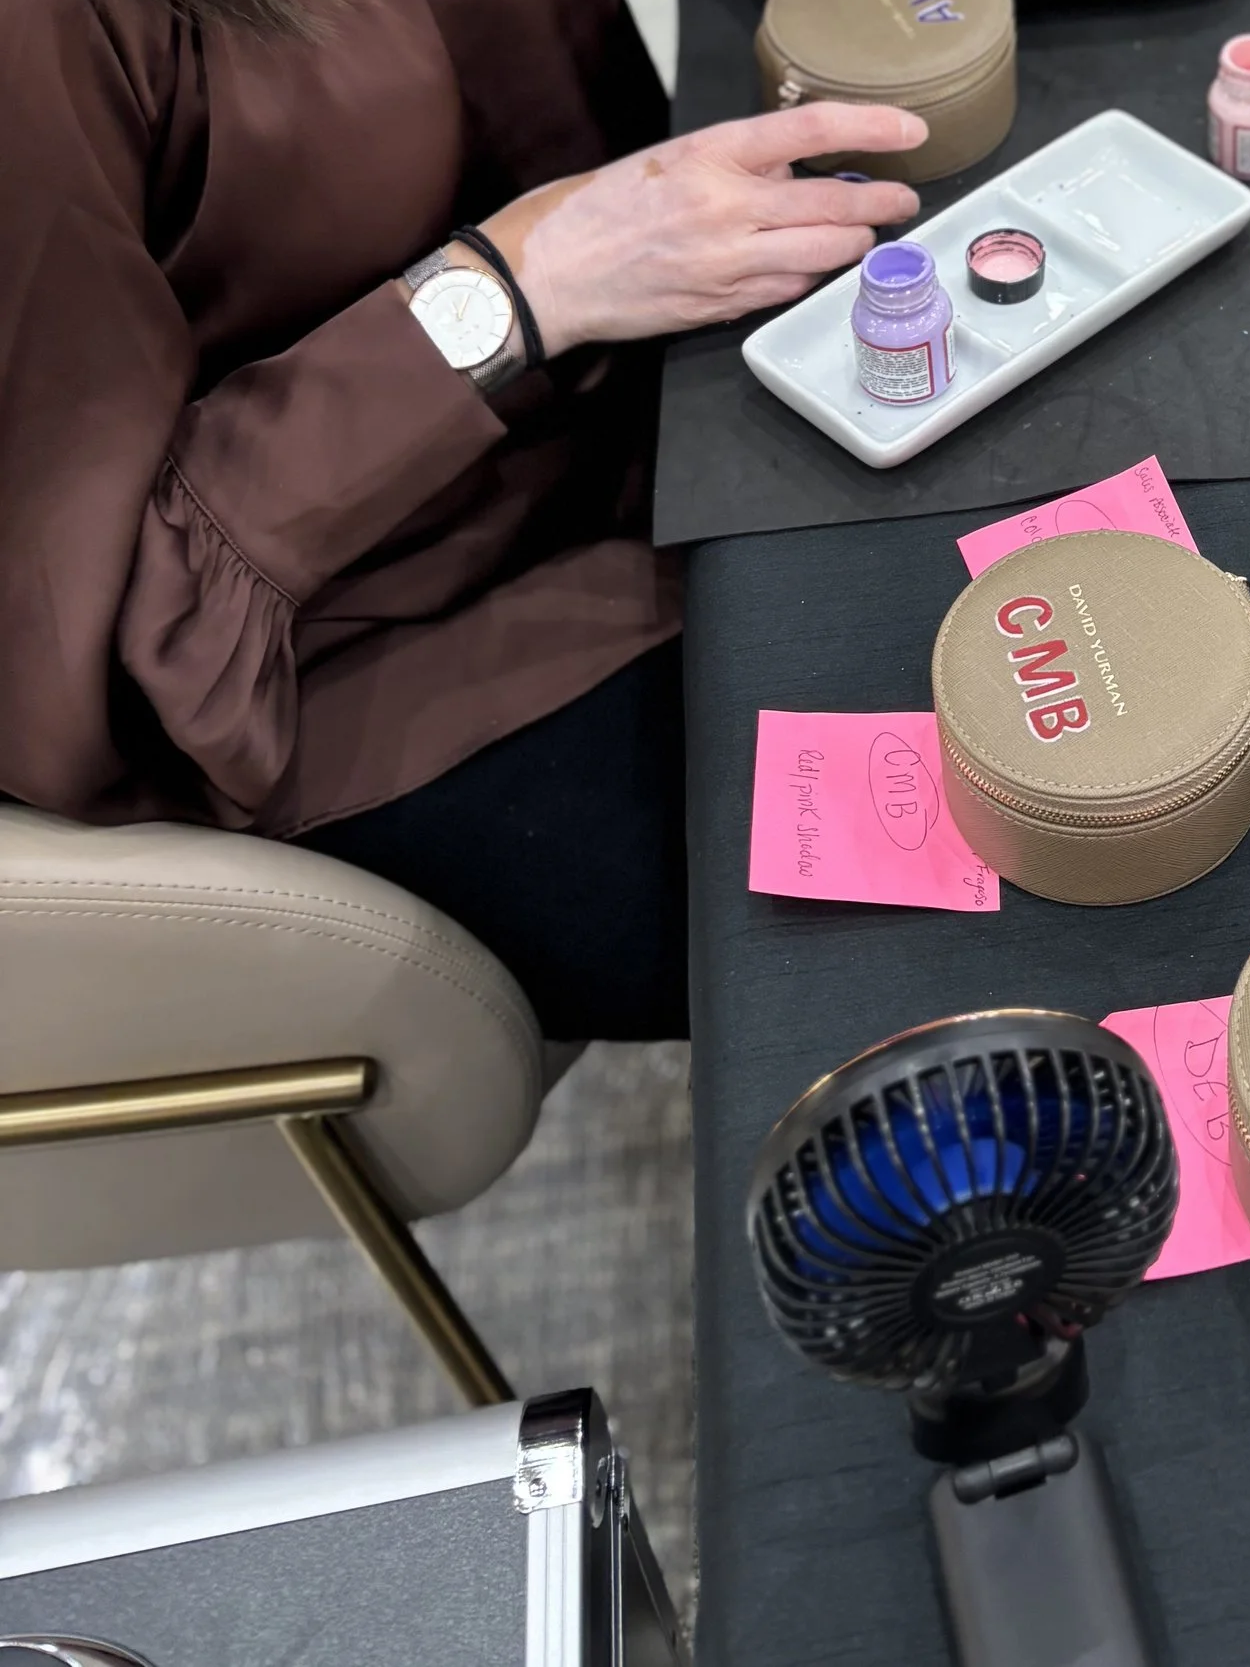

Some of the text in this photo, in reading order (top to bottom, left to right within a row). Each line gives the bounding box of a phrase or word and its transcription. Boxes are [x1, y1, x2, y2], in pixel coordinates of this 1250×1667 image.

[995, 594, 1091, 743] CMB
[1069, 584, 1128, 717] DAVID YURMAN
[884, 749, 920, 819] CMB
